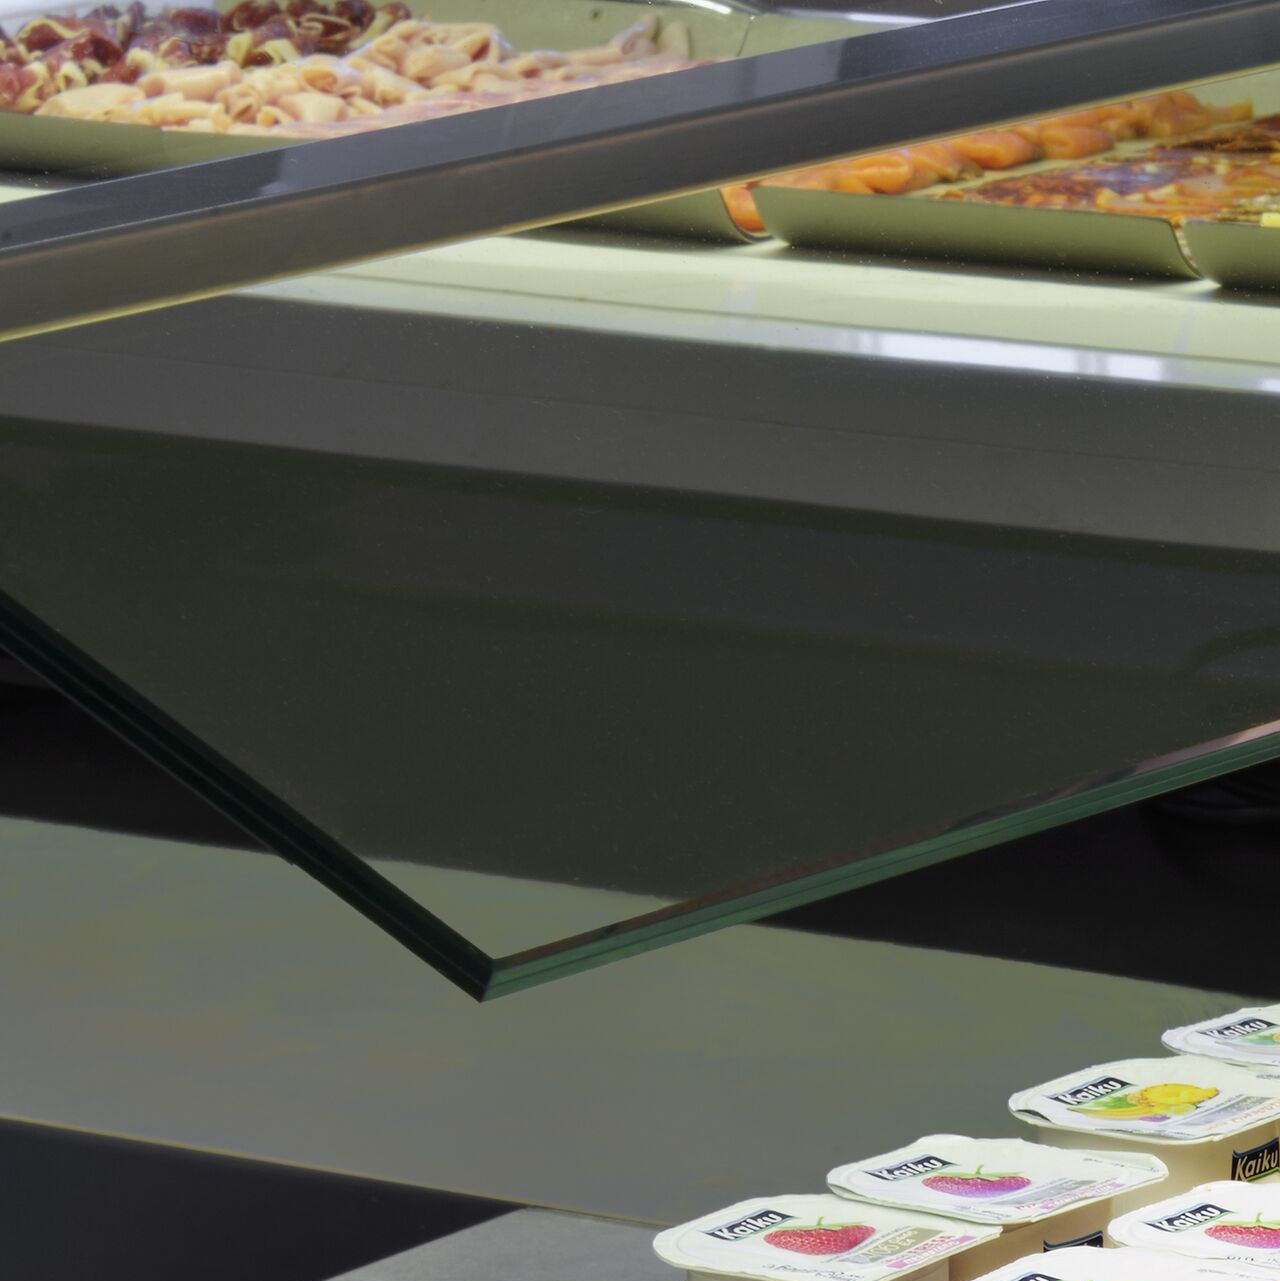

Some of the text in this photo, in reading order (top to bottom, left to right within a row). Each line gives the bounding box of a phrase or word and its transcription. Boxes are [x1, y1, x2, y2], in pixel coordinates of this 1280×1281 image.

[1206, 1019, 1269, 1041] Kaiku
[1058, 1078, 1123, 1107] Kaiku
[877, 1156, 944, 1181] Kaiku
[1234, 1146, 1279, 1182] Kaiku
[715, 1211, 782, 1241] Kaiku
[1155, 1206, 1222, 1233] Kaiku
